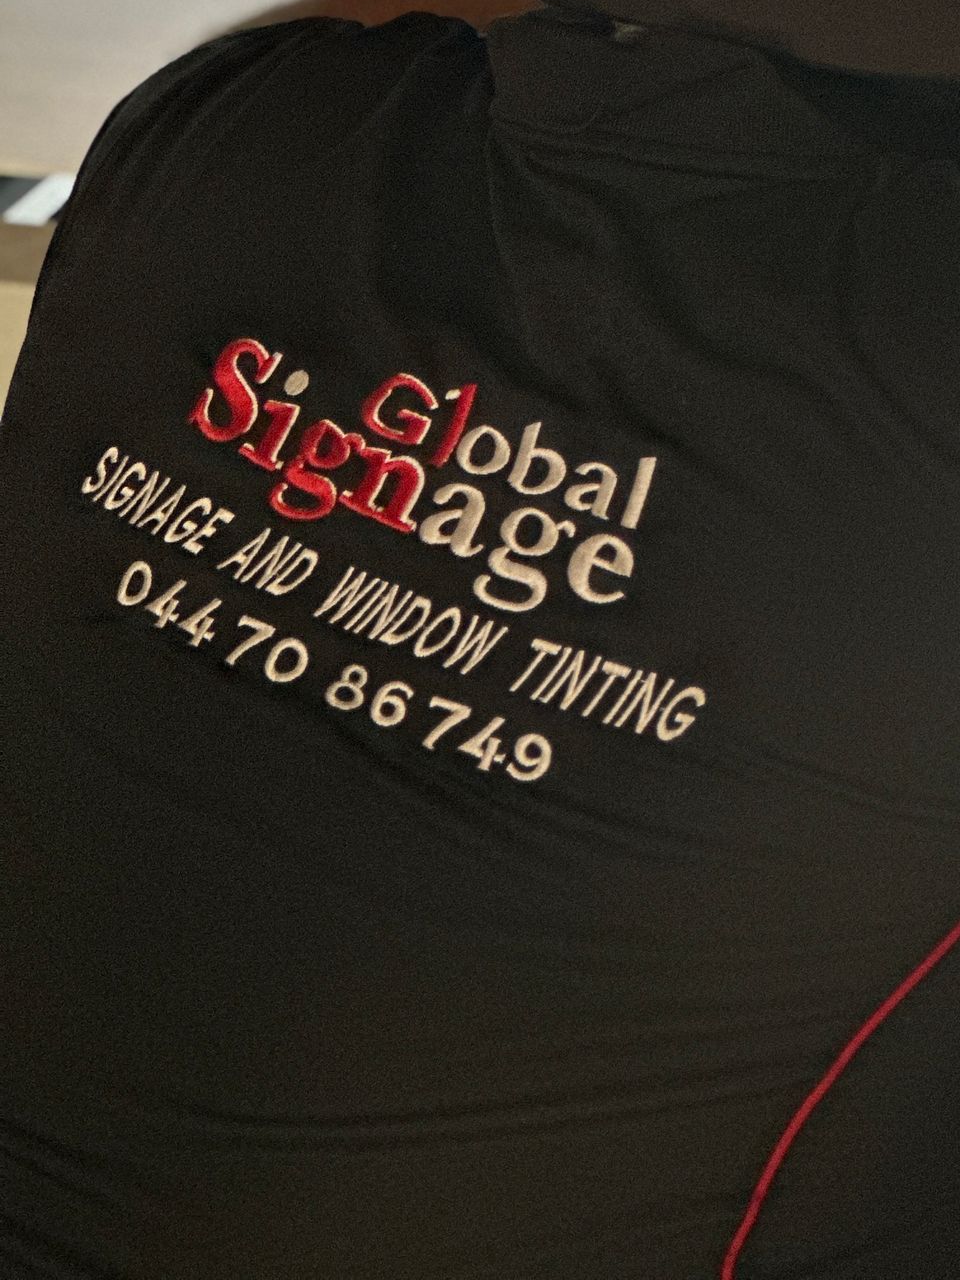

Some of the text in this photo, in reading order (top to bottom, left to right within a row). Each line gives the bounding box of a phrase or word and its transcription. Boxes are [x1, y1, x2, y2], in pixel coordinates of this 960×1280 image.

[189, 338, 637, 613] Signage
[362, 372, 658, 530] Global
[81, 446, 707, 742] SIGNAGE AND WINDOW TINTING
